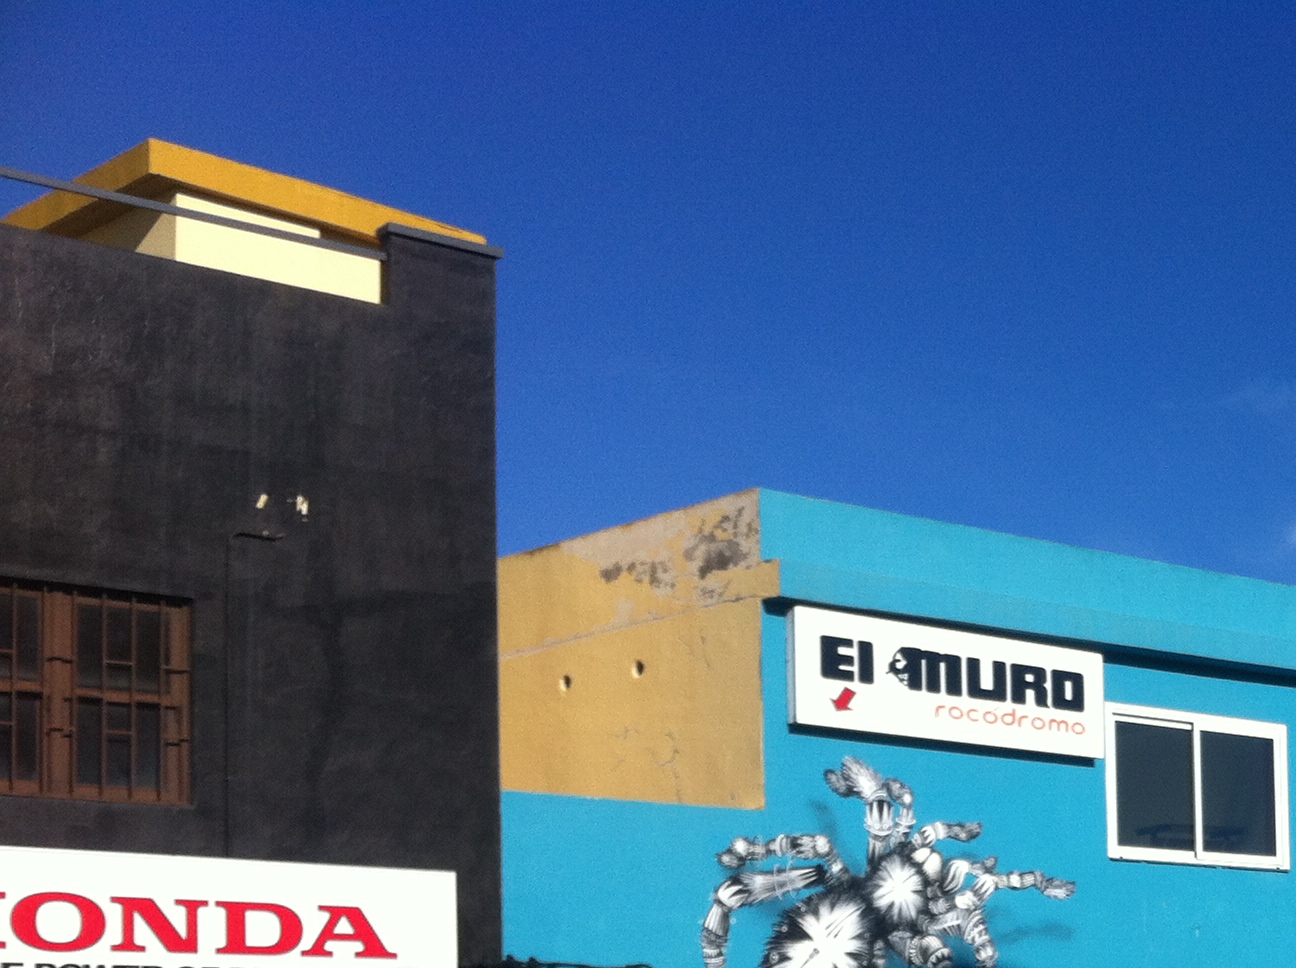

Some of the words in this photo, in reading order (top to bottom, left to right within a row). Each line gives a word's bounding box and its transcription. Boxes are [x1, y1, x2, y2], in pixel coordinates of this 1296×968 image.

[819, 634, 875, 685] El
[899, 646, 1085, 713] MURO
[0, 891, 398, 959] ONDA
